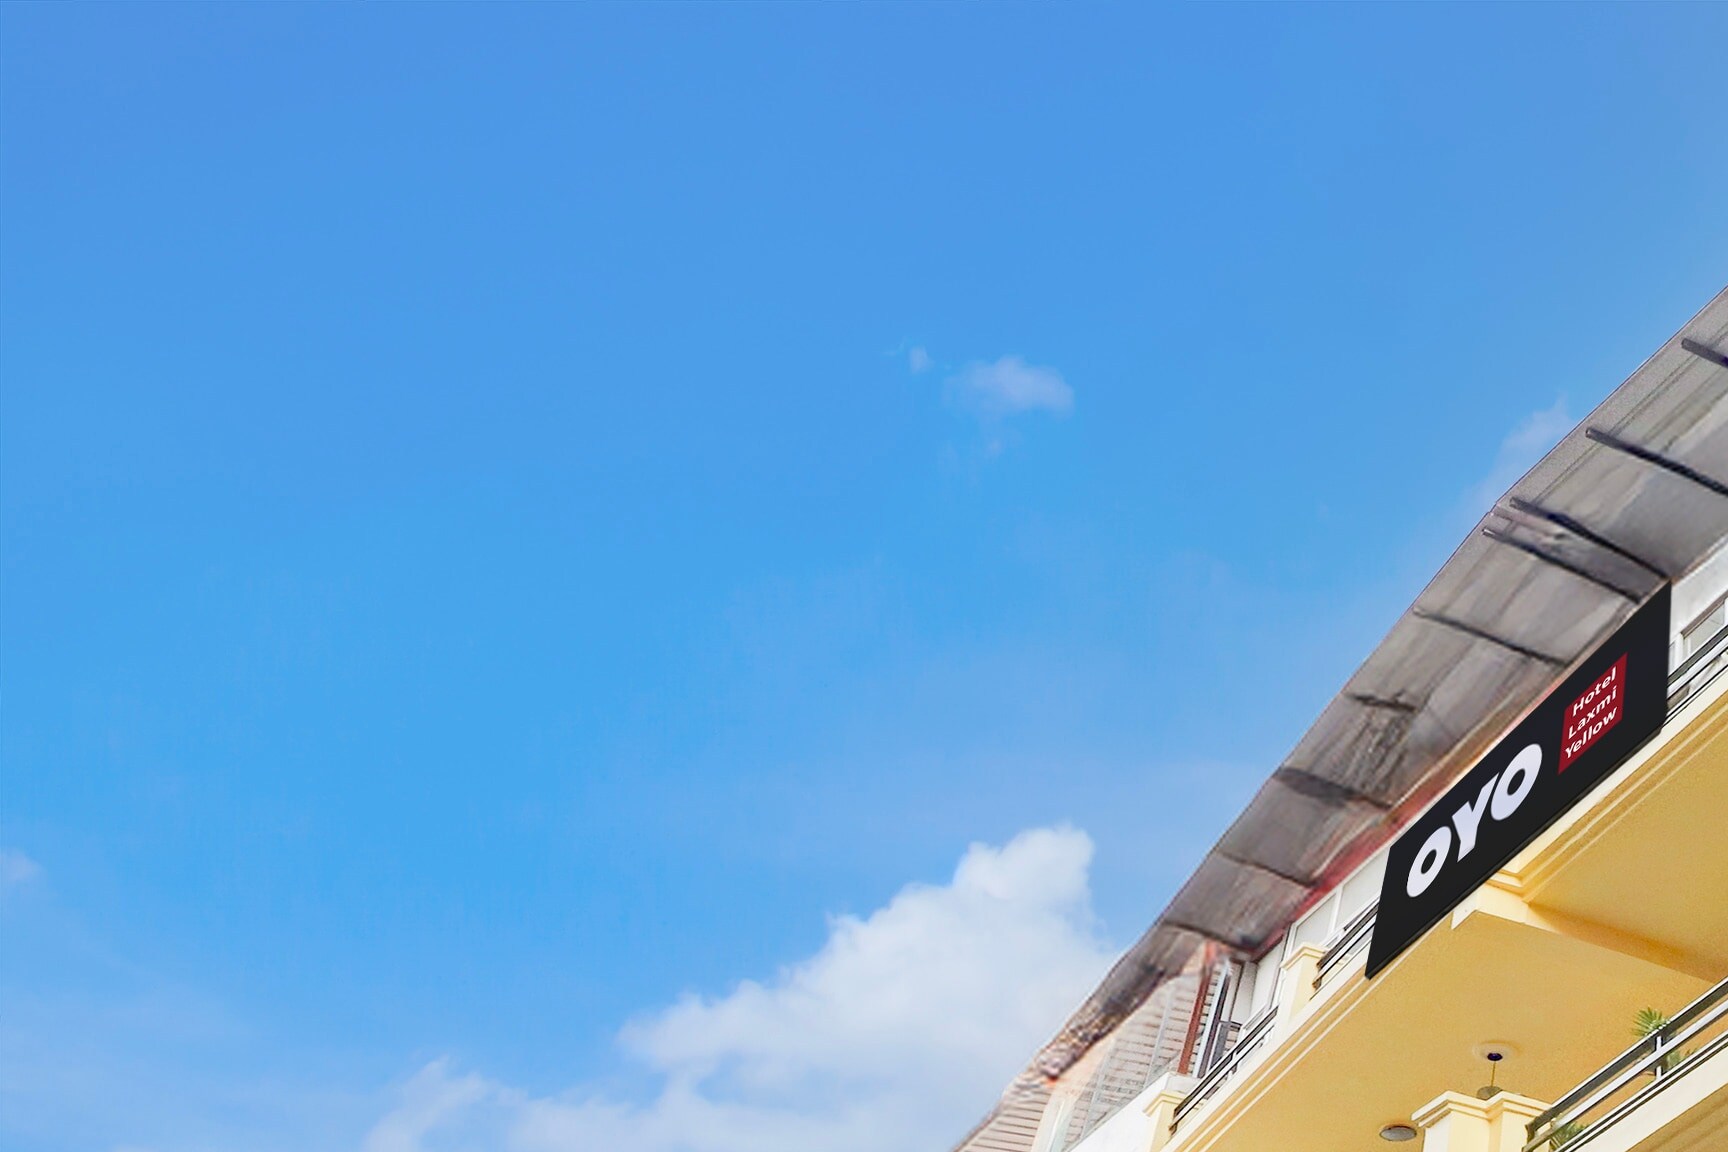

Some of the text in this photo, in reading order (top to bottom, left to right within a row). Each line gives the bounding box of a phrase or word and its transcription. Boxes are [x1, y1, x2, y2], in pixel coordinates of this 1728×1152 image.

[1568, 686, 1617, 739] Laxmi
[1573, 666, 1616, 717] Hotel
[1565, 707, 1617, 758] Yellow
[1406, 743, 1543, 898] OYO
